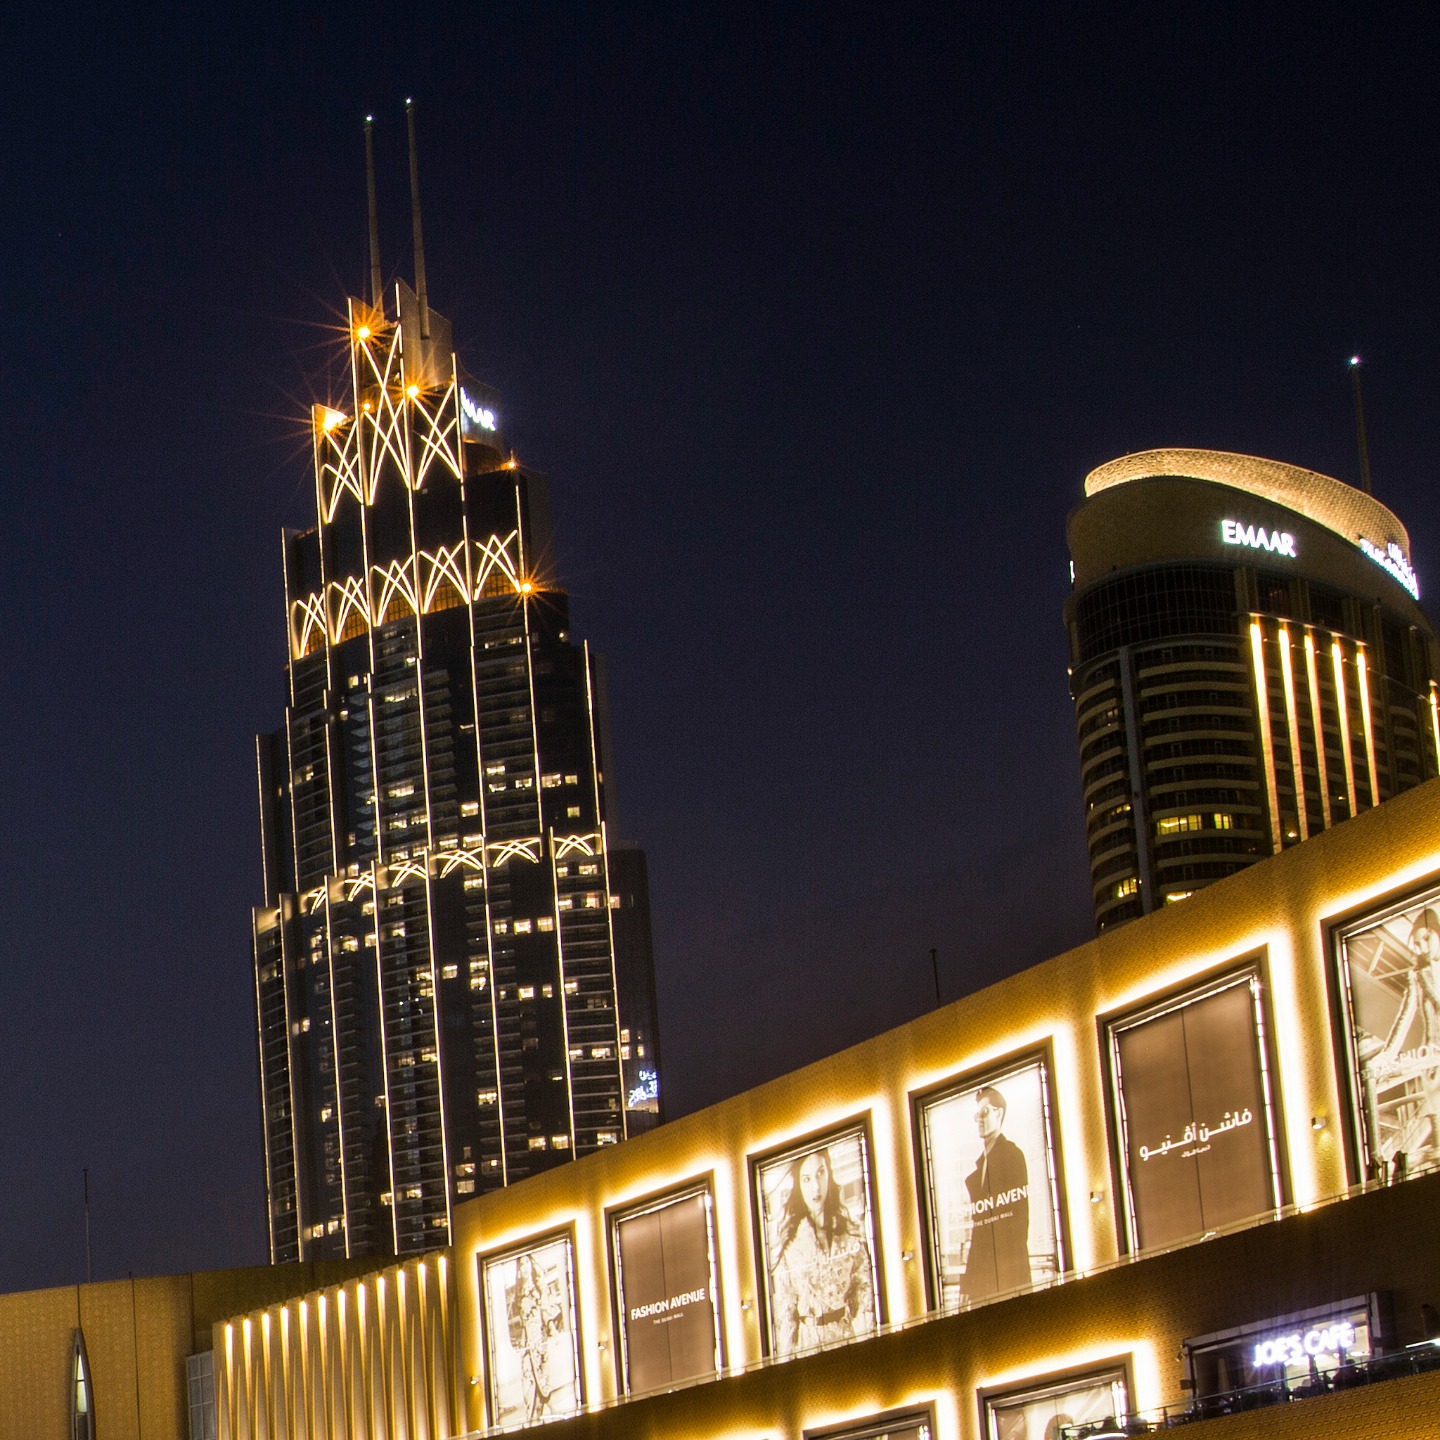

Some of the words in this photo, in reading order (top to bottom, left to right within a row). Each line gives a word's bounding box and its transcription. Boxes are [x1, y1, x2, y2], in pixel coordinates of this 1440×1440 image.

[1221, 519, 1296, 558] EMAAR
[630, 1299, 670, 1321] FASHION
[670, 1287, 706, 1310] AVENUE
